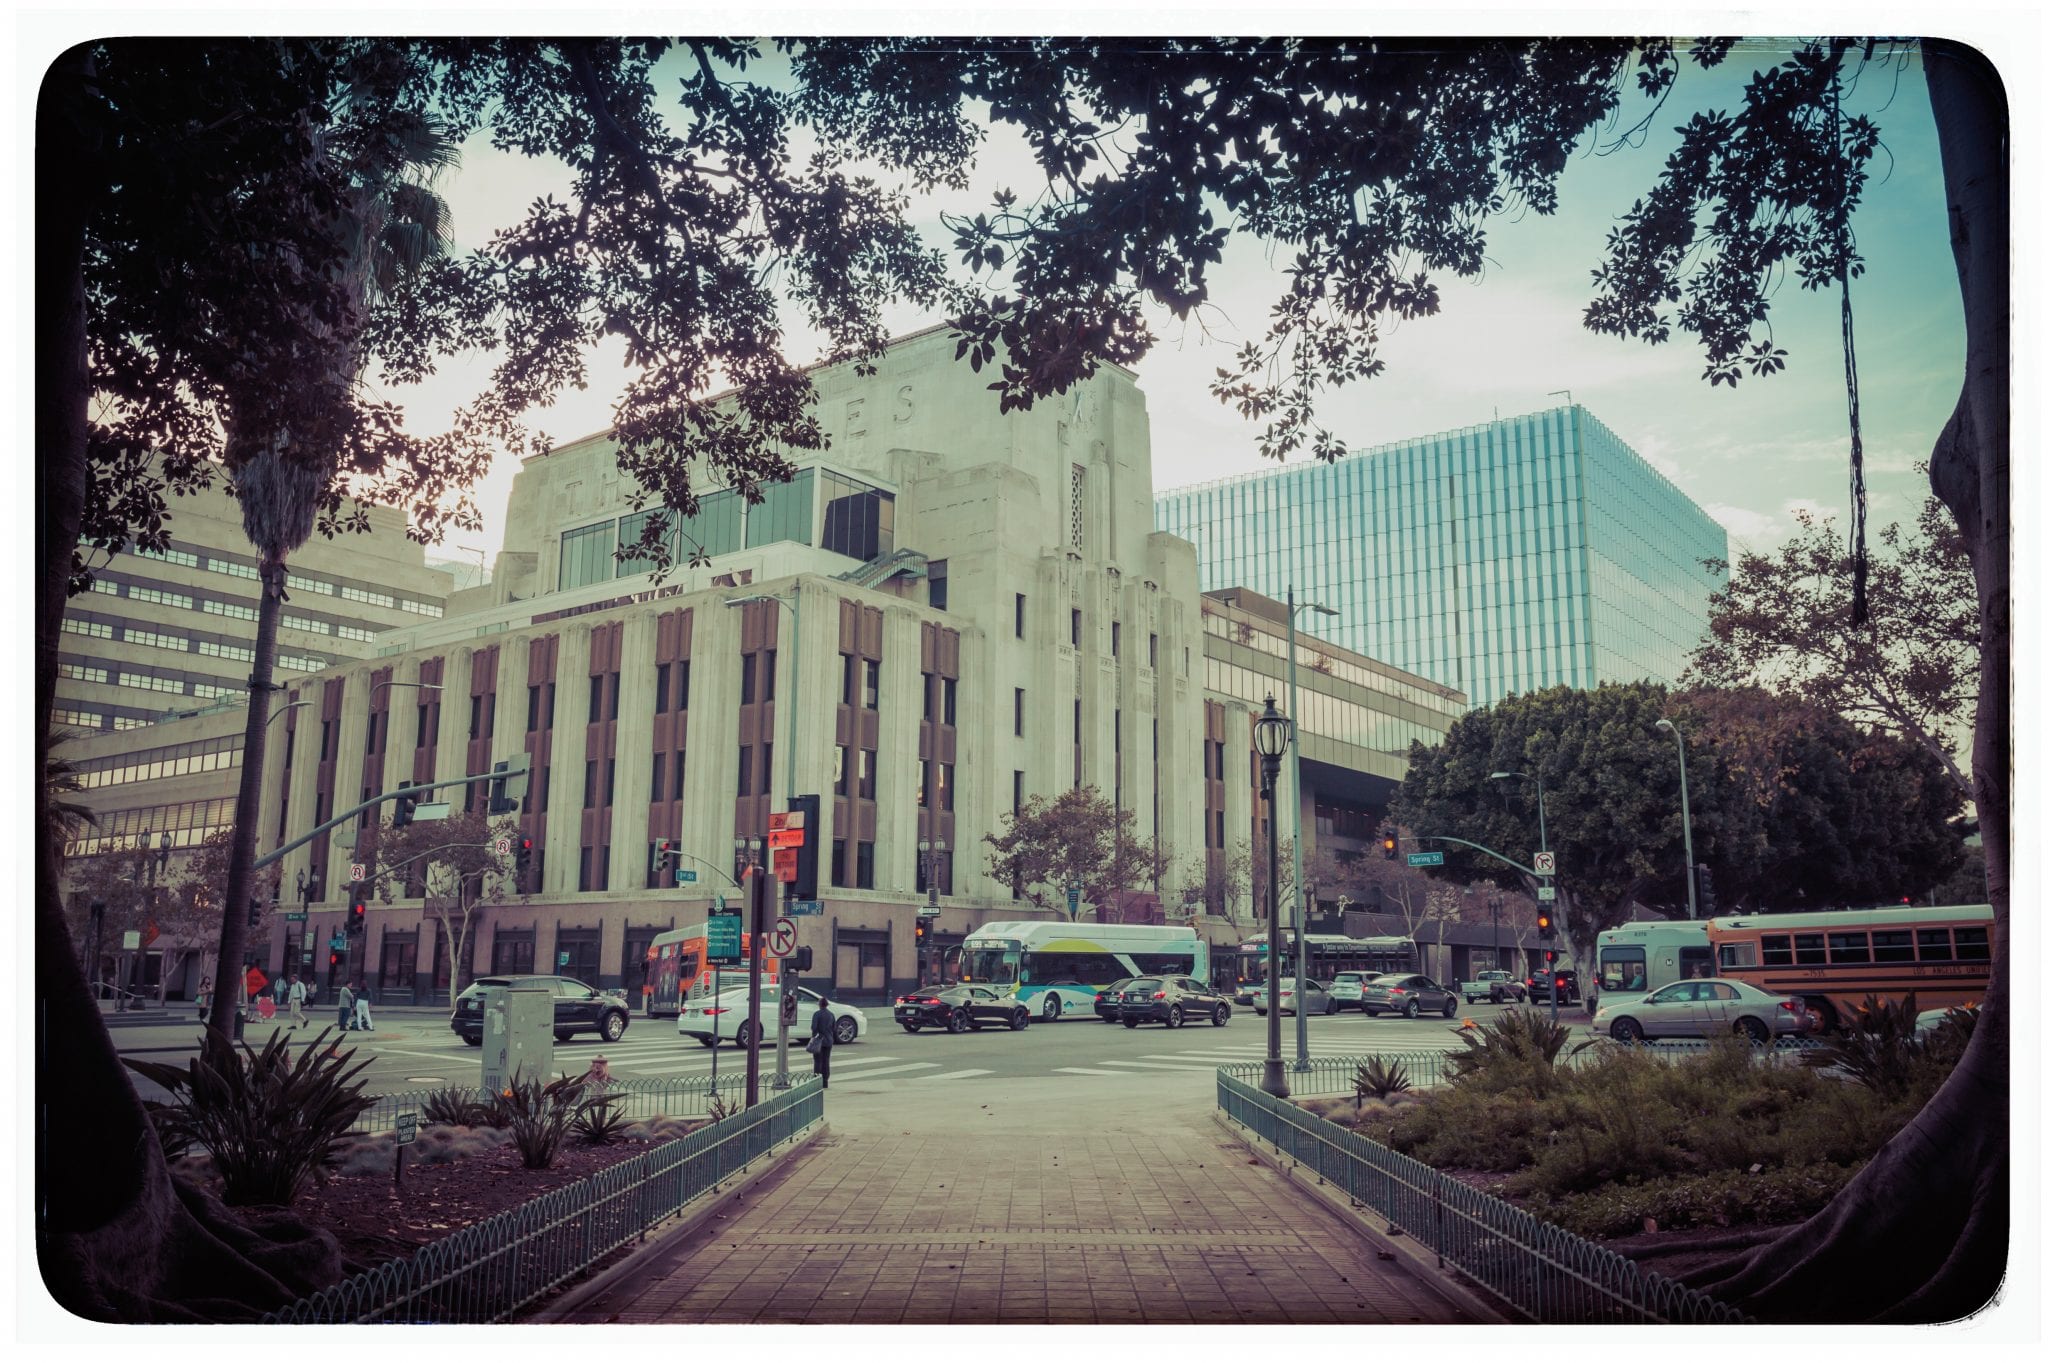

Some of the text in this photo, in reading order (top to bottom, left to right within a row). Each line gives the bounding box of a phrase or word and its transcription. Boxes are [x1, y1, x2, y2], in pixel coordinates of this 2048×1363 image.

[1411, 856, 1431, 864] Spring
[1913, 967, 1926, 976] LOS
[1932, 966, 1962, 975] ANGELES
[399, 1115, 416, 1126] KEEP OFF
[399, 1127, 416, 1135] PLANTED
[400, 1133, 413, 1141] AREAS
